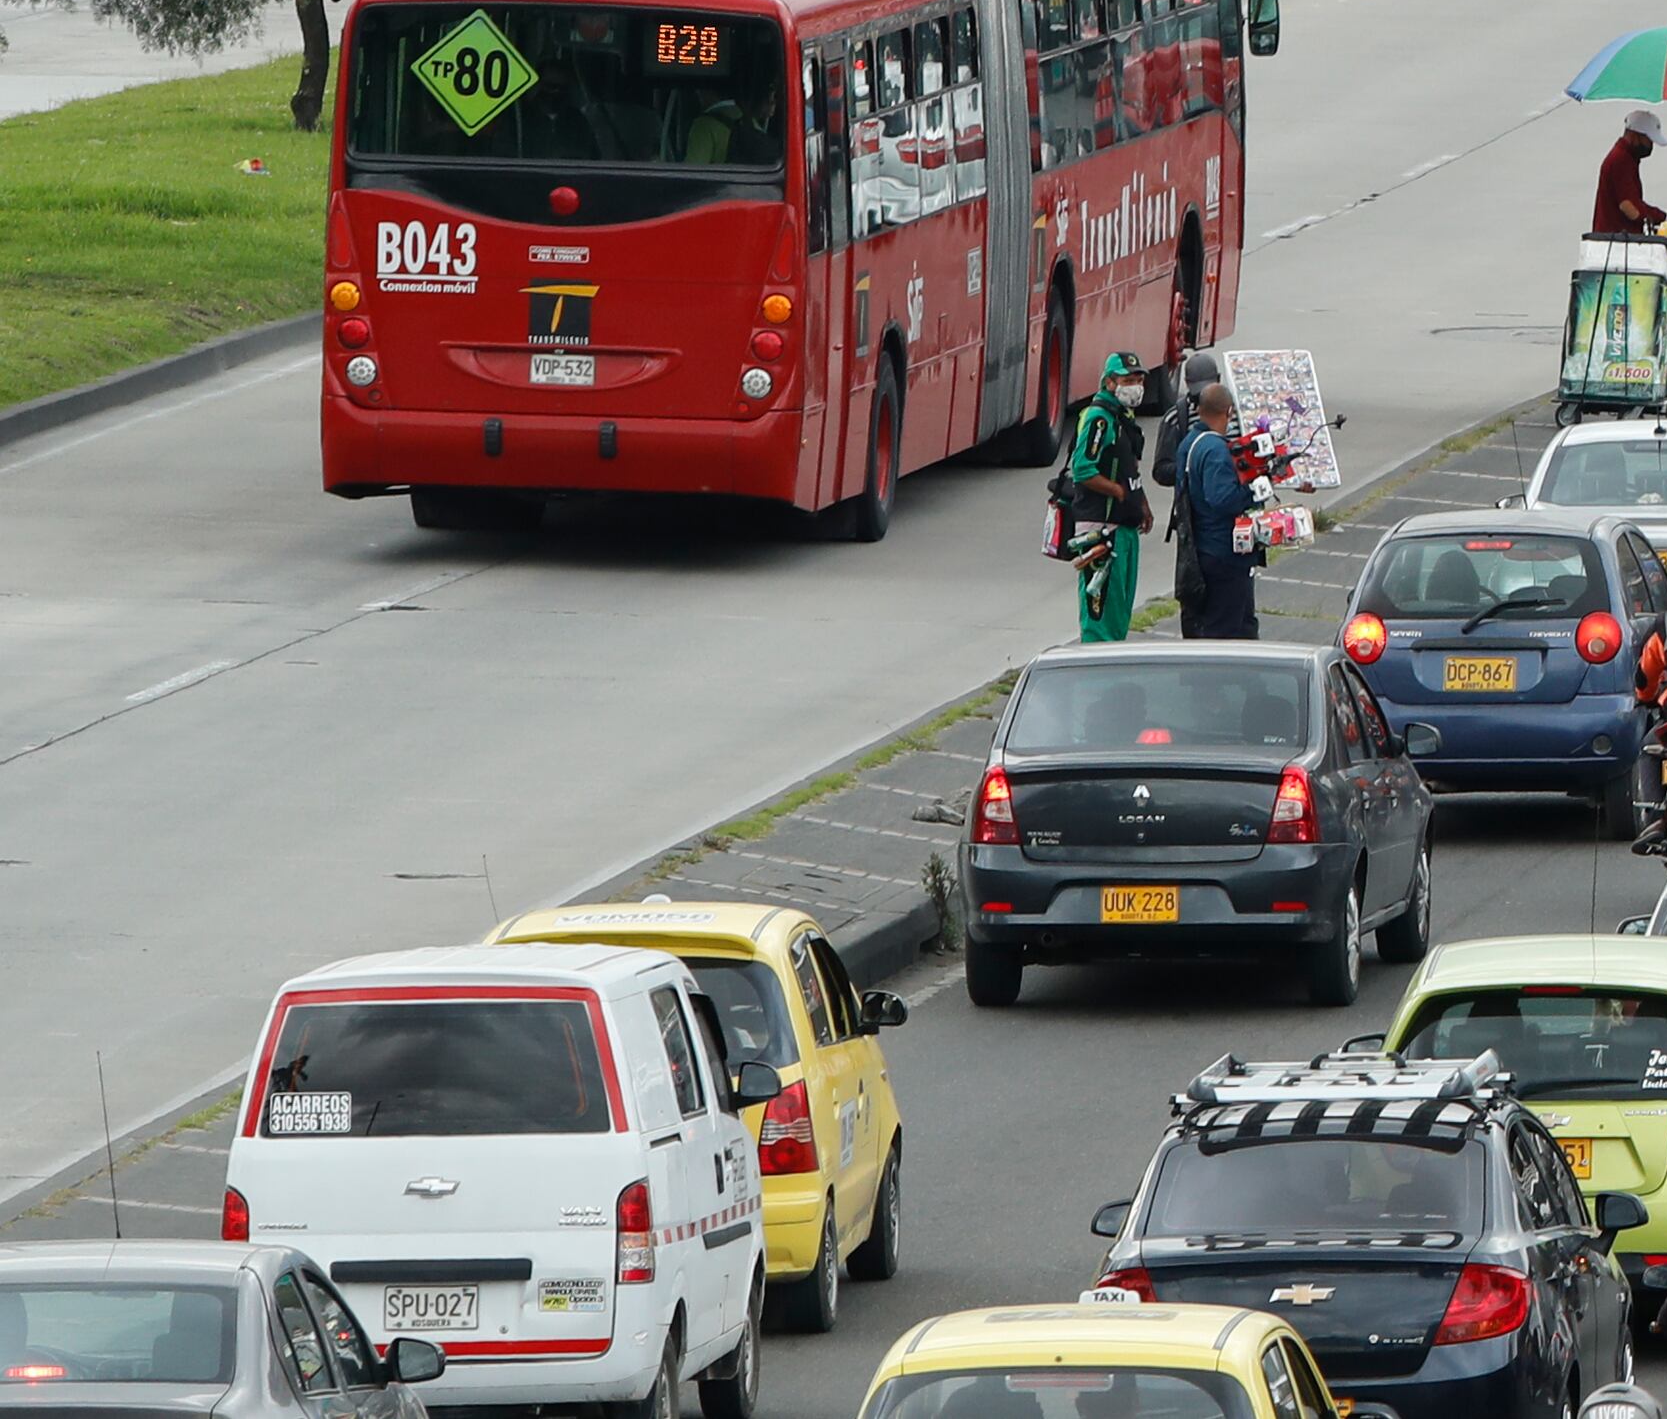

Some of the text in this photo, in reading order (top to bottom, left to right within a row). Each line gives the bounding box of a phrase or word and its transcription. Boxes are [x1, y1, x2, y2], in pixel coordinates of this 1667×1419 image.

[376, 221, 477, 276] B043
[379, 279, 476, 294] Connexion móvil
[272, 1094, 349, 1113] ACARREOS
[1093, 1292, 1125, 1301] TAXI
